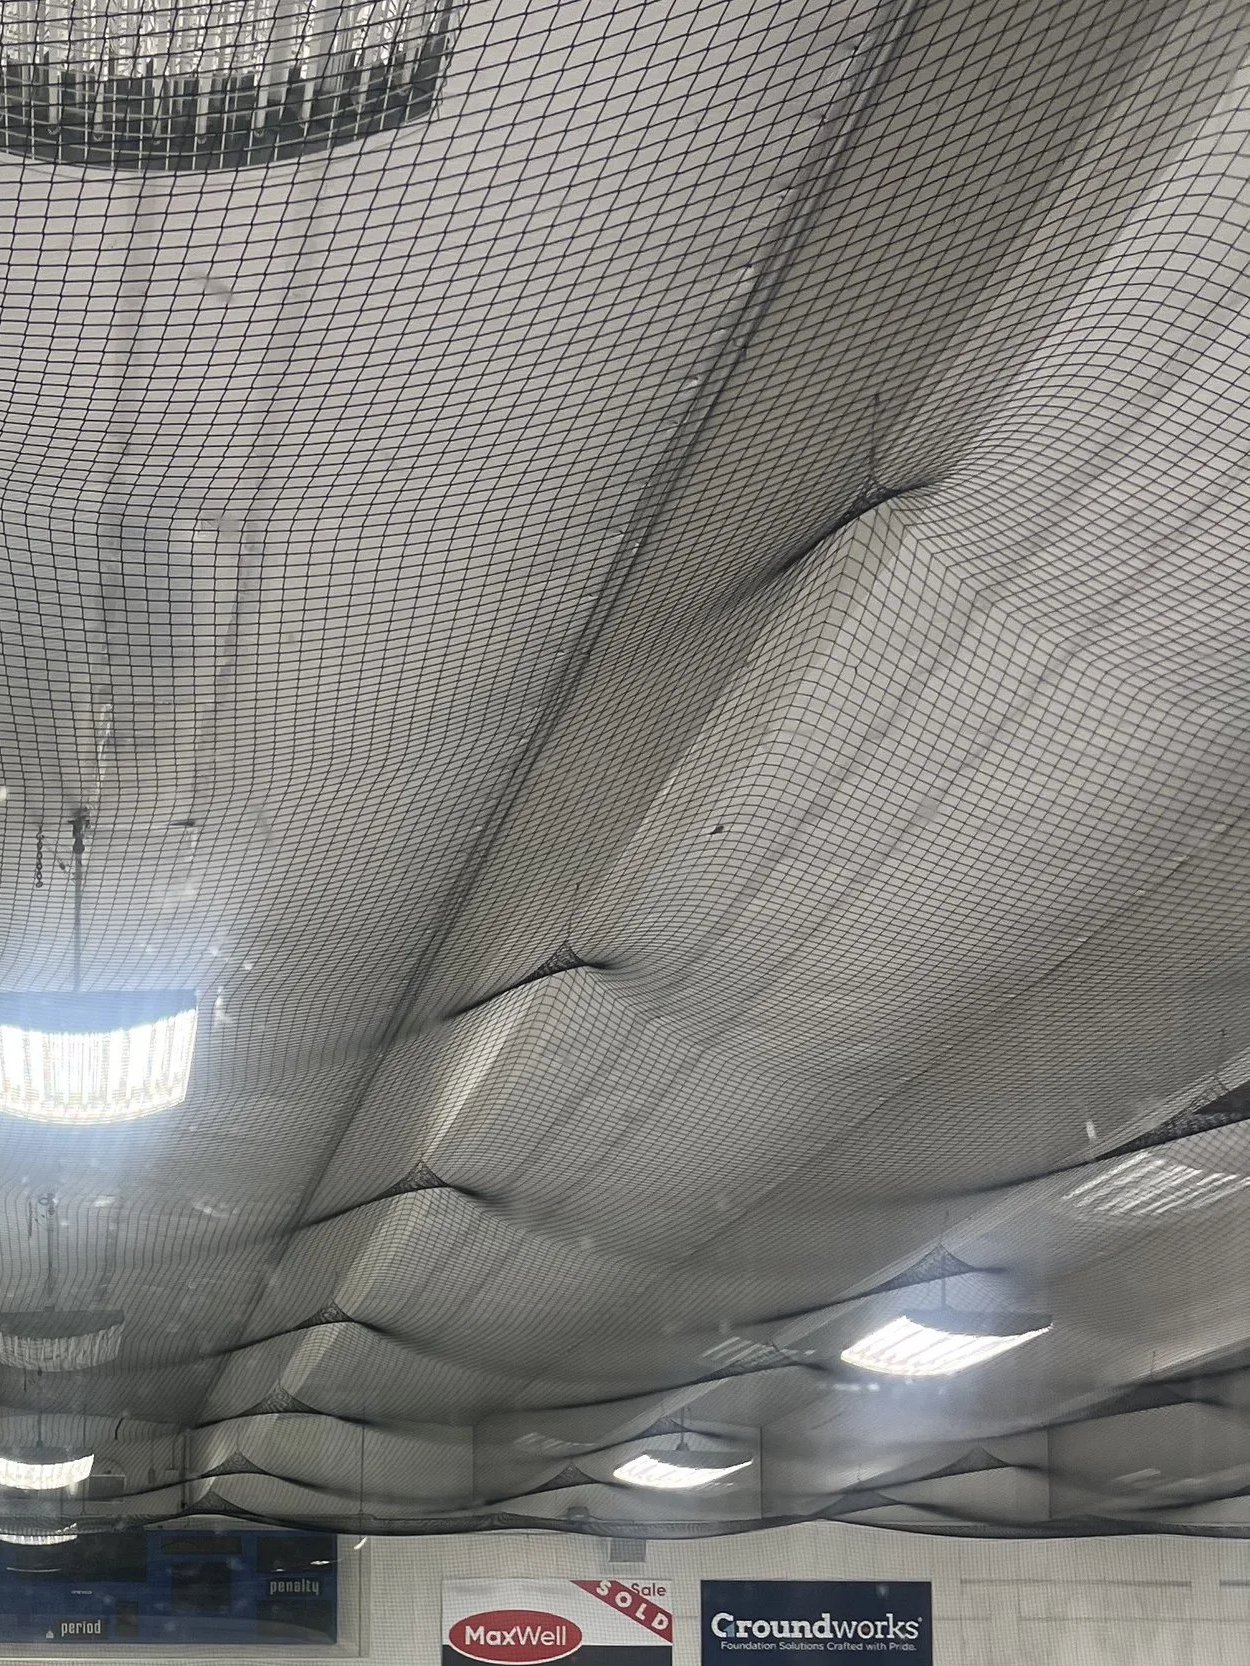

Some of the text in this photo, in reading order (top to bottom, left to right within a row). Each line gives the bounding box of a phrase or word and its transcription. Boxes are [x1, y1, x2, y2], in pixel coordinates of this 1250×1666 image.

[270, 1578, 319, 1595] penalty
[595, 1580, 669, 1631] SOLD
[61, 1619, 101, 1637] period
[711, 1612, 919, 1639] Groundworks
[464, 1626, 566, 1646] MaxWell
[721, 1641, 776, 1651] Foundation
[779, 1641, 825, 1651] Solutions
[827, 1641, 863, 1651] Crafted
[866, 1642, 887, 1651] with
